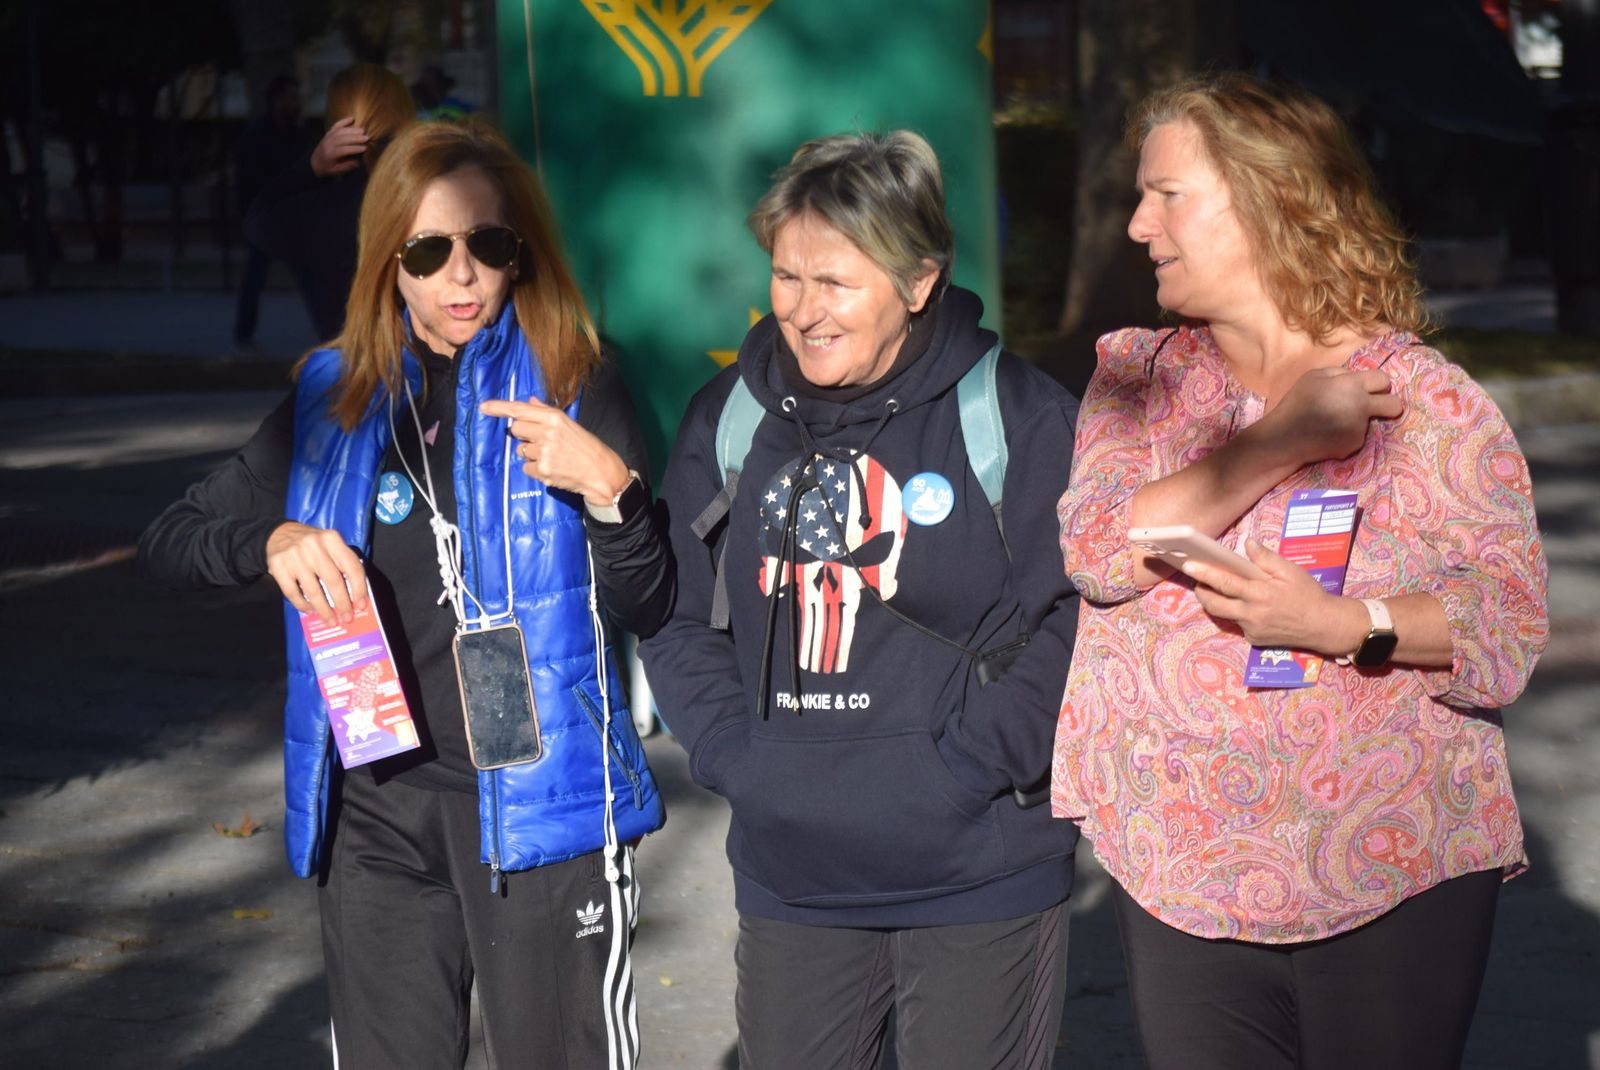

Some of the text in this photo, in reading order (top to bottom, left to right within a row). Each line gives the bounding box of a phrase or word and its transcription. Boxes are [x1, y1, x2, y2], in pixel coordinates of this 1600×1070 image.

[834, 693, 846, 710] &
[848, 693, 870, 709] CO
[576, 925, 604, 939] adidas
